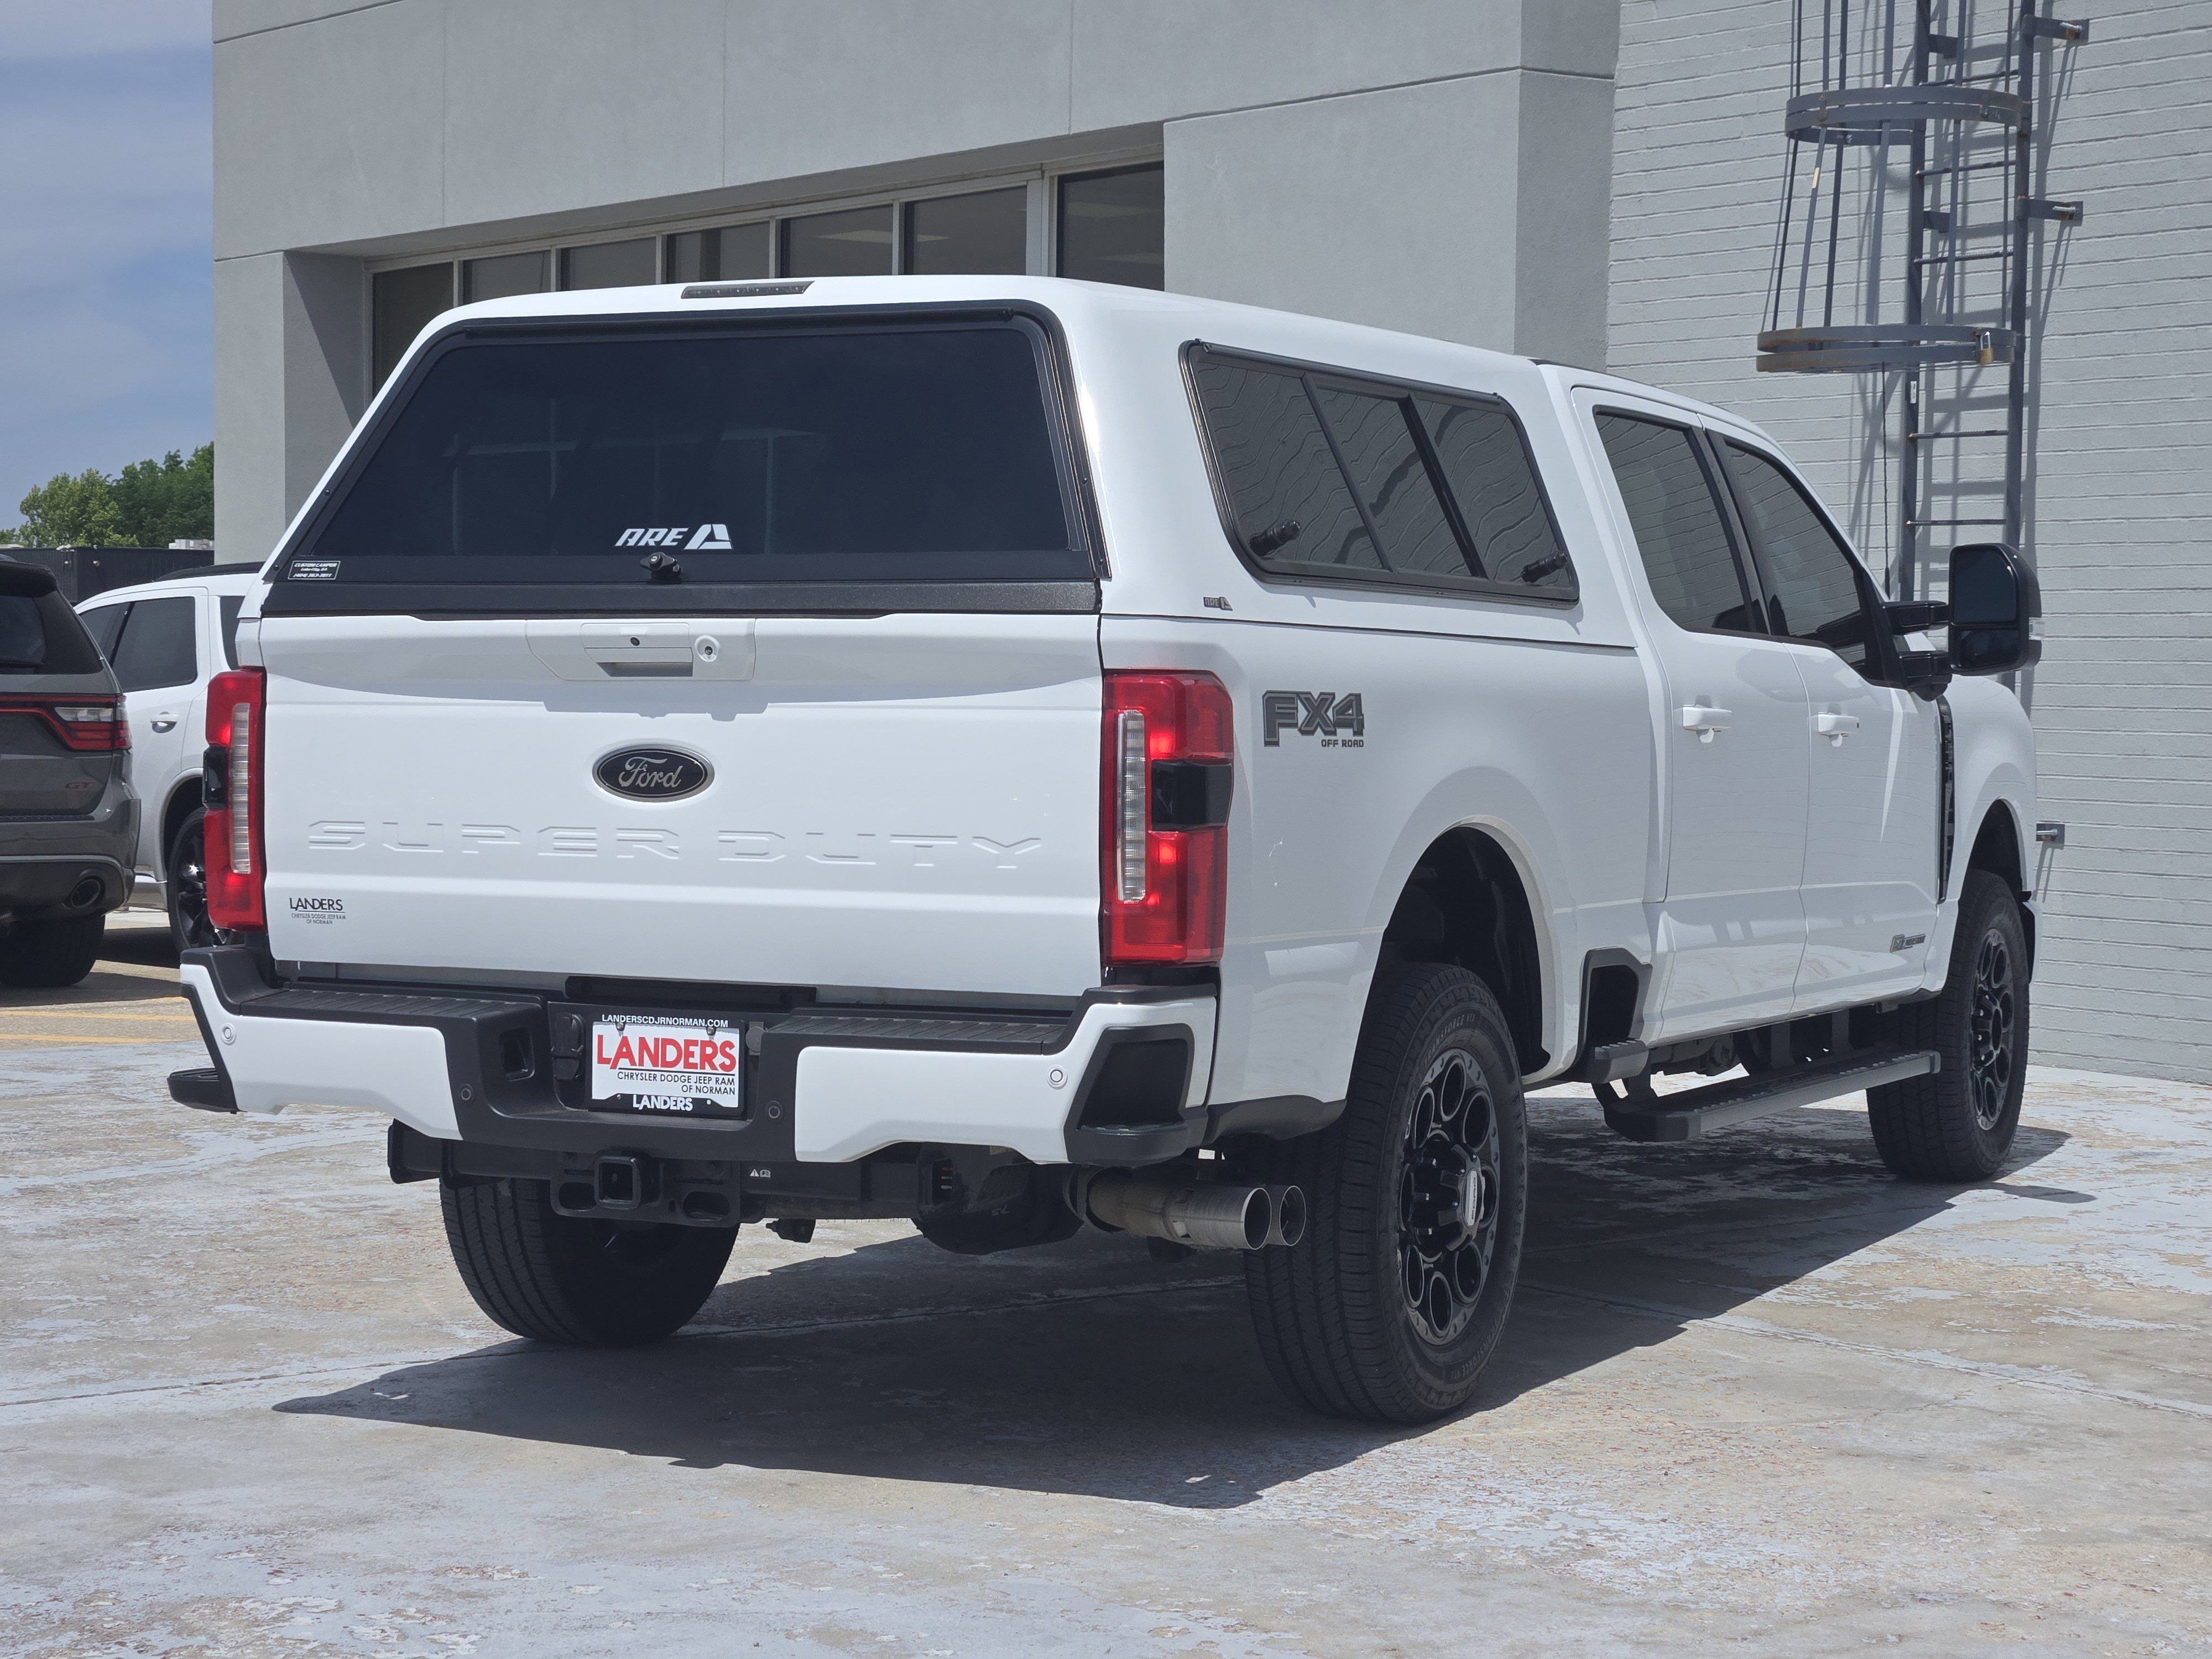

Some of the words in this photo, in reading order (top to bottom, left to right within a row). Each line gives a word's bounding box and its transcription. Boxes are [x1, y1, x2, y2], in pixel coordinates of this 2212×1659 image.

[614, 528, 689, 546] ARE
[1262, 690, 1365, 747] FX4
[1321, 739, 1338, 747] OFF
[1342, 739, 1364, 748] ROAD
[618, 756, 684, 788] Ford
[309, 820, 679, 859] SUPER
[718, 831, 1041, 868] DUTY
[289, 898, 343, 911] LANDERS
[602, 1014, 729, 1028] LANDERSCDJRNORMAN.COM
[597, 1035, 737, 1072] LANDERS
[617, 1072, 658, 1082] CHRYSLER
[660, 1074, 692, 1084] DODGE
[694, 1076, 712, 1085] JEEP
[714, 1077, 735, 1086] RAM
[681, 1084, 693, 1093] OF
[695, 1086, 735, 1095] NORMAN
[633, 1094, 693, 1112] LANDERS
